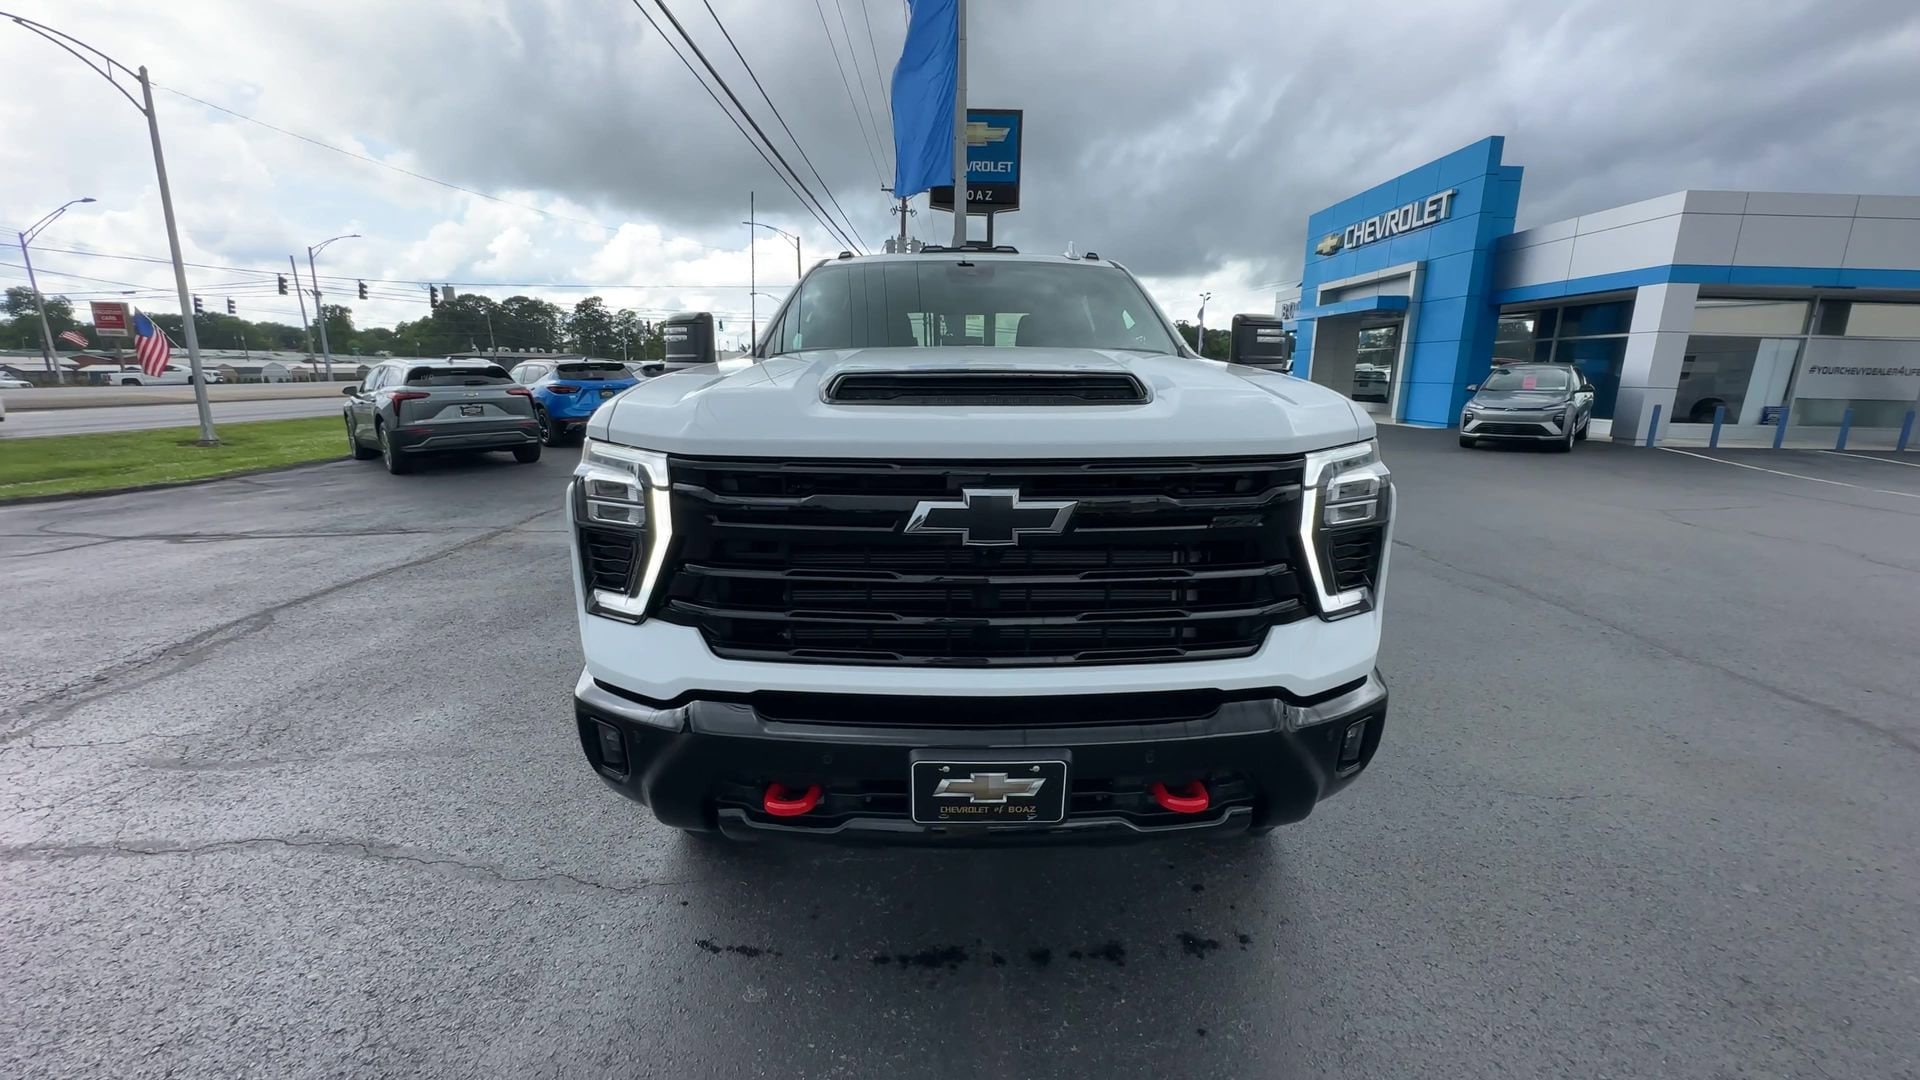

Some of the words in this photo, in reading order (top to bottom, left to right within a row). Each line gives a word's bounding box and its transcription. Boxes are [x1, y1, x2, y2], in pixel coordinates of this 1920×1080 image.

[967, 161, 1014, 172] VROLET
[967, 190, 993, 201] OAZ
[1343, 188, 1457, 250] CHEVROLET
[940, 806, 989, 814] CHEVROLET
